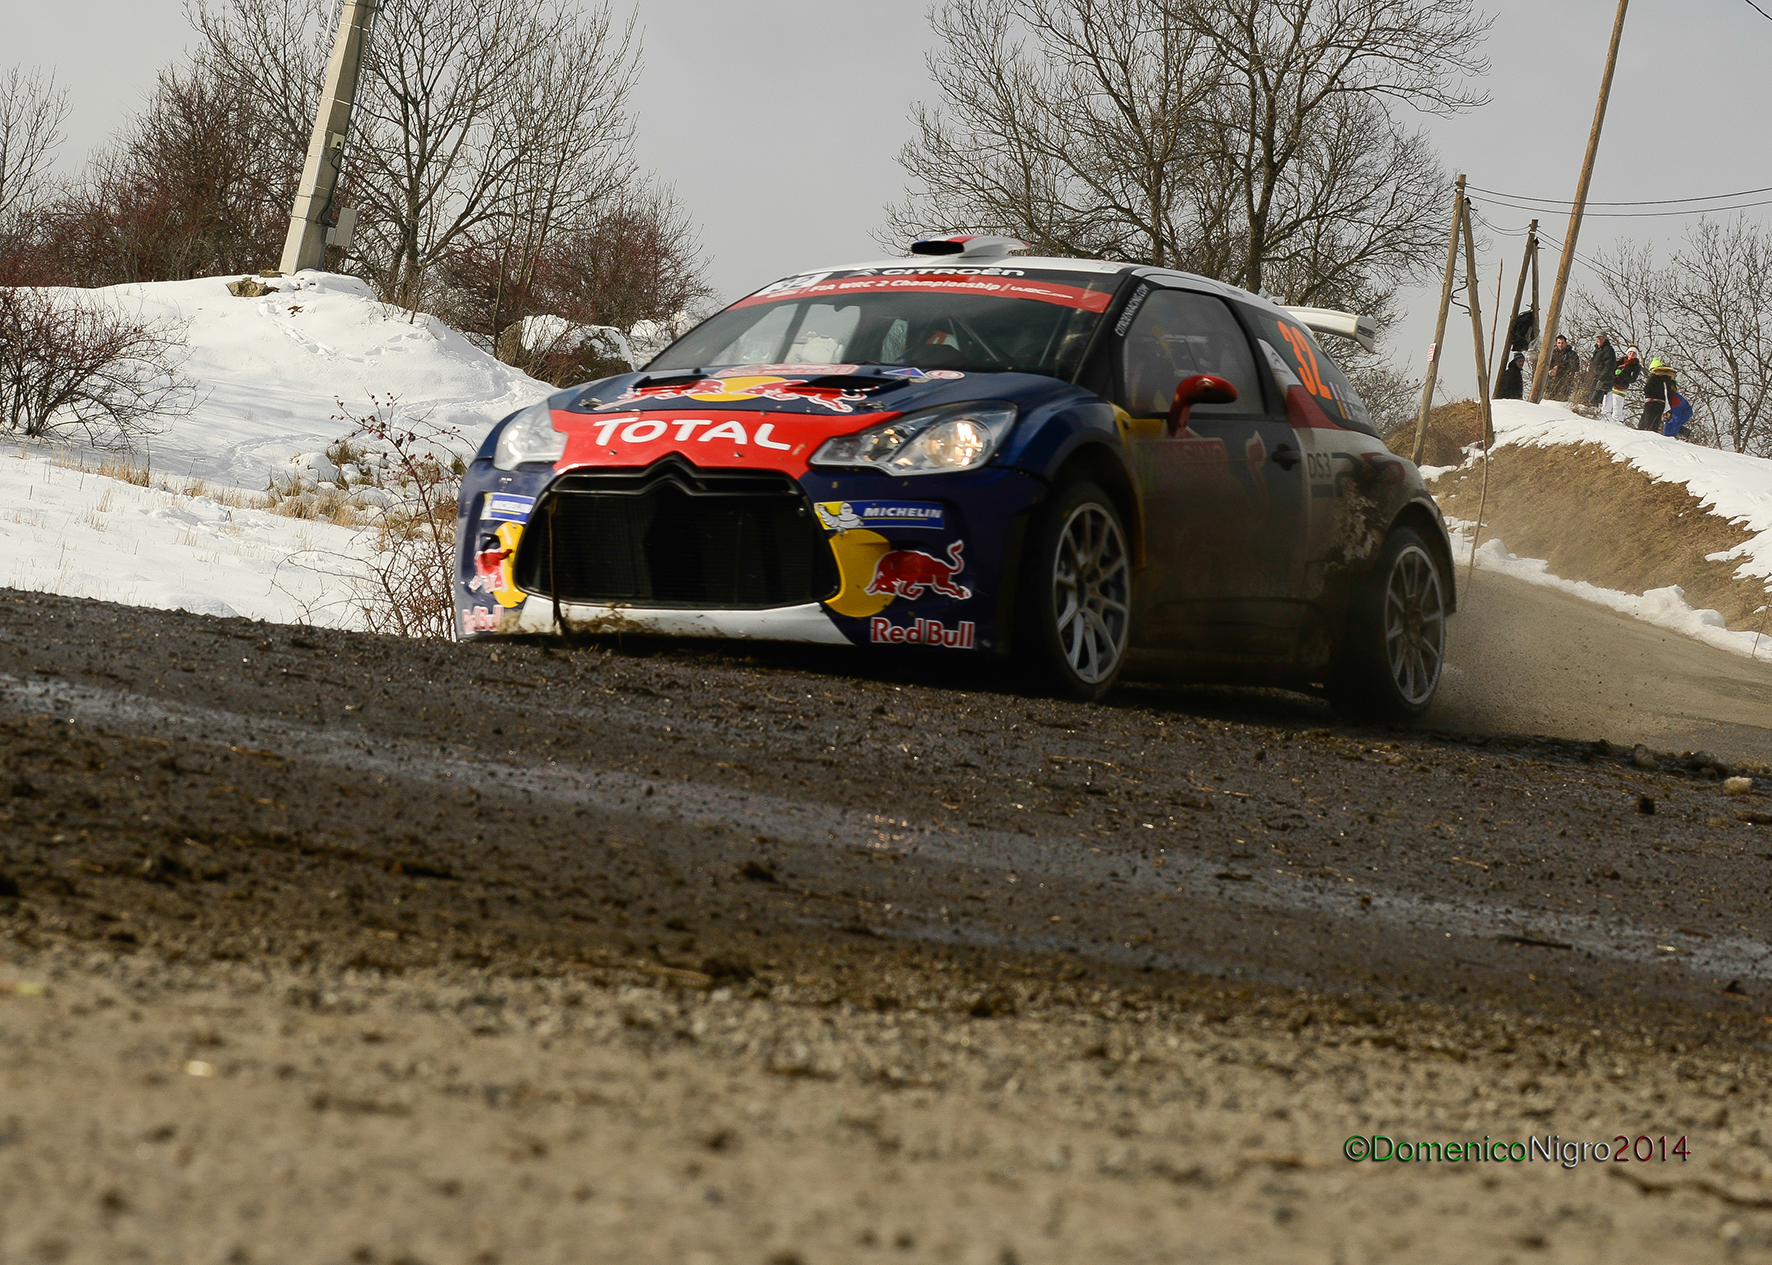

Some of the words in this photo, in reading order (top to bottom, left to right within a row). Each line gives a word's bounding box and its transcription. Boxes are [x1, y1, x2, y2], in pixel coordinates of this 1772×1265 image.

[838, 281, 875, 289] WRC
[890, 280, 1001, 291] Championship
[1277, 320, 1333, 400] 32
[593, 417, 792, 451] TOTAL
[1307, 452, 1332, 479] DS3
[863, 507, 942, 519] MICHELIN
